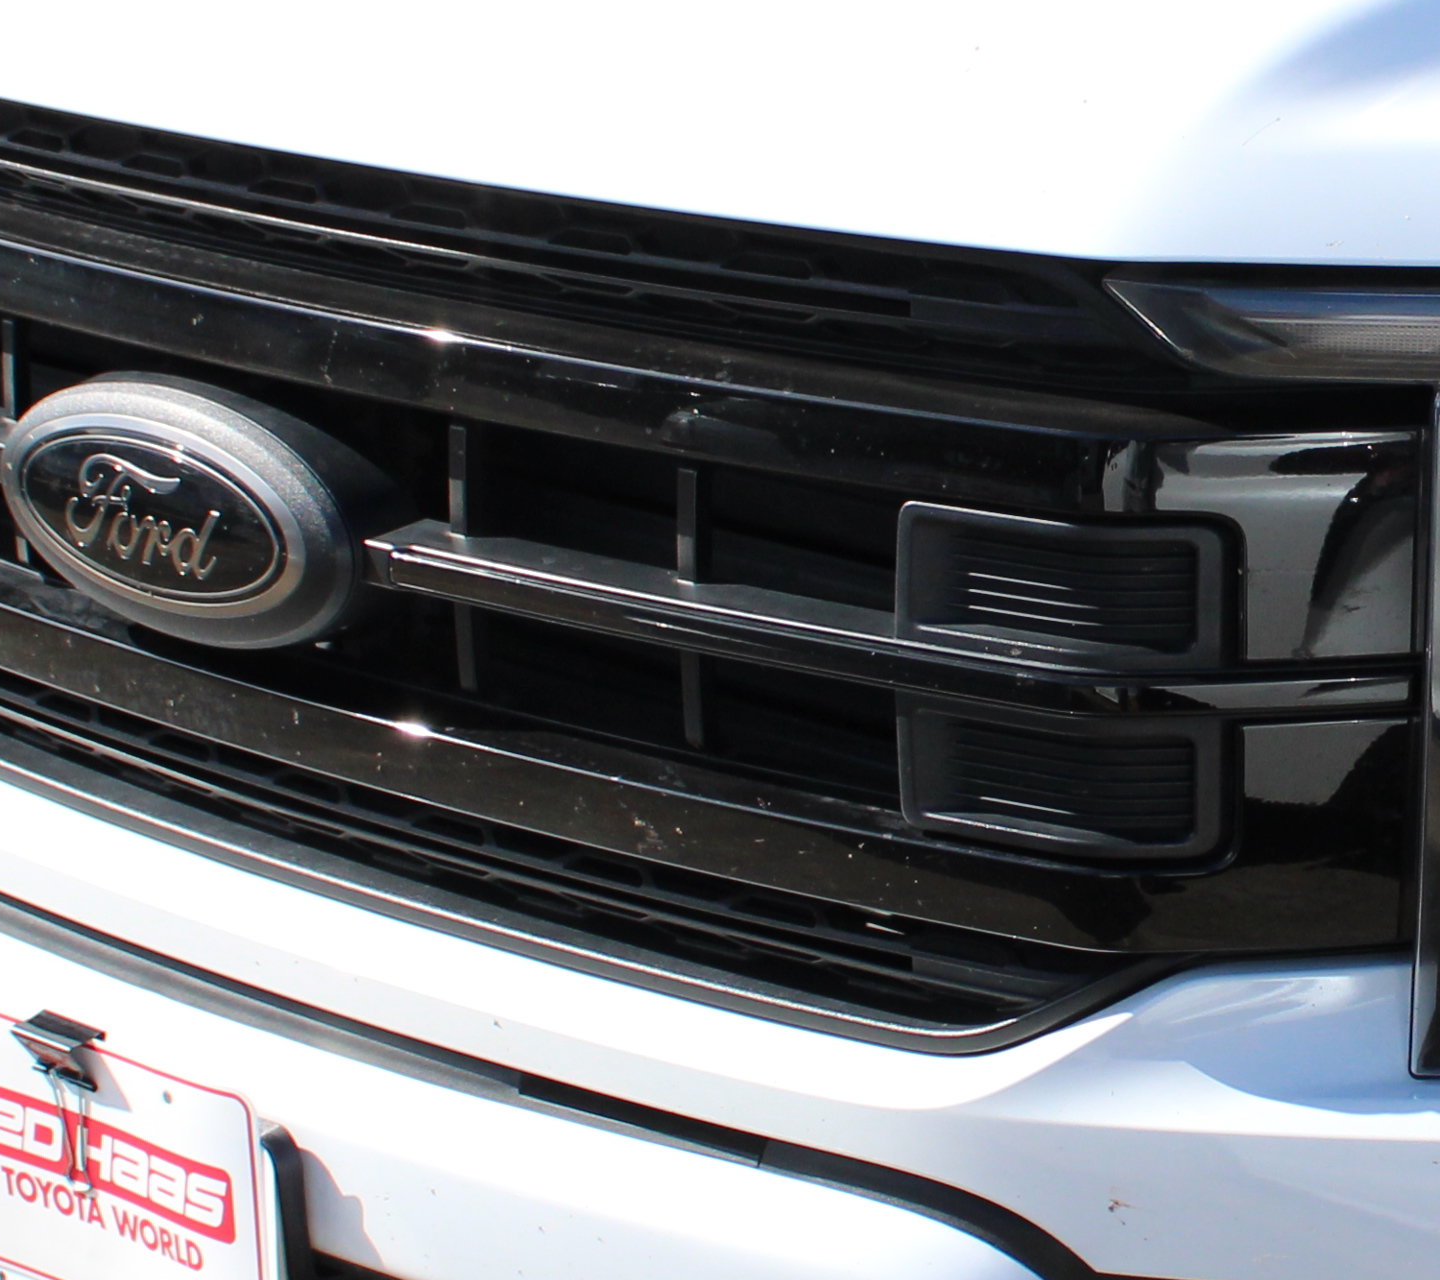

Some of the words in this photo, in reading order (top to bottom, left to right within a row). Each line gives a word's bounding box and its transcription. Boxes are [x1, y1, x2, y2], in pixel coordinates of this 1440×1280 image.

[64, 452, 224, 582] Ford
[2, 1166, 106, 1229] TOYOTA
[112, 1205, 203, 1271] WORLD
